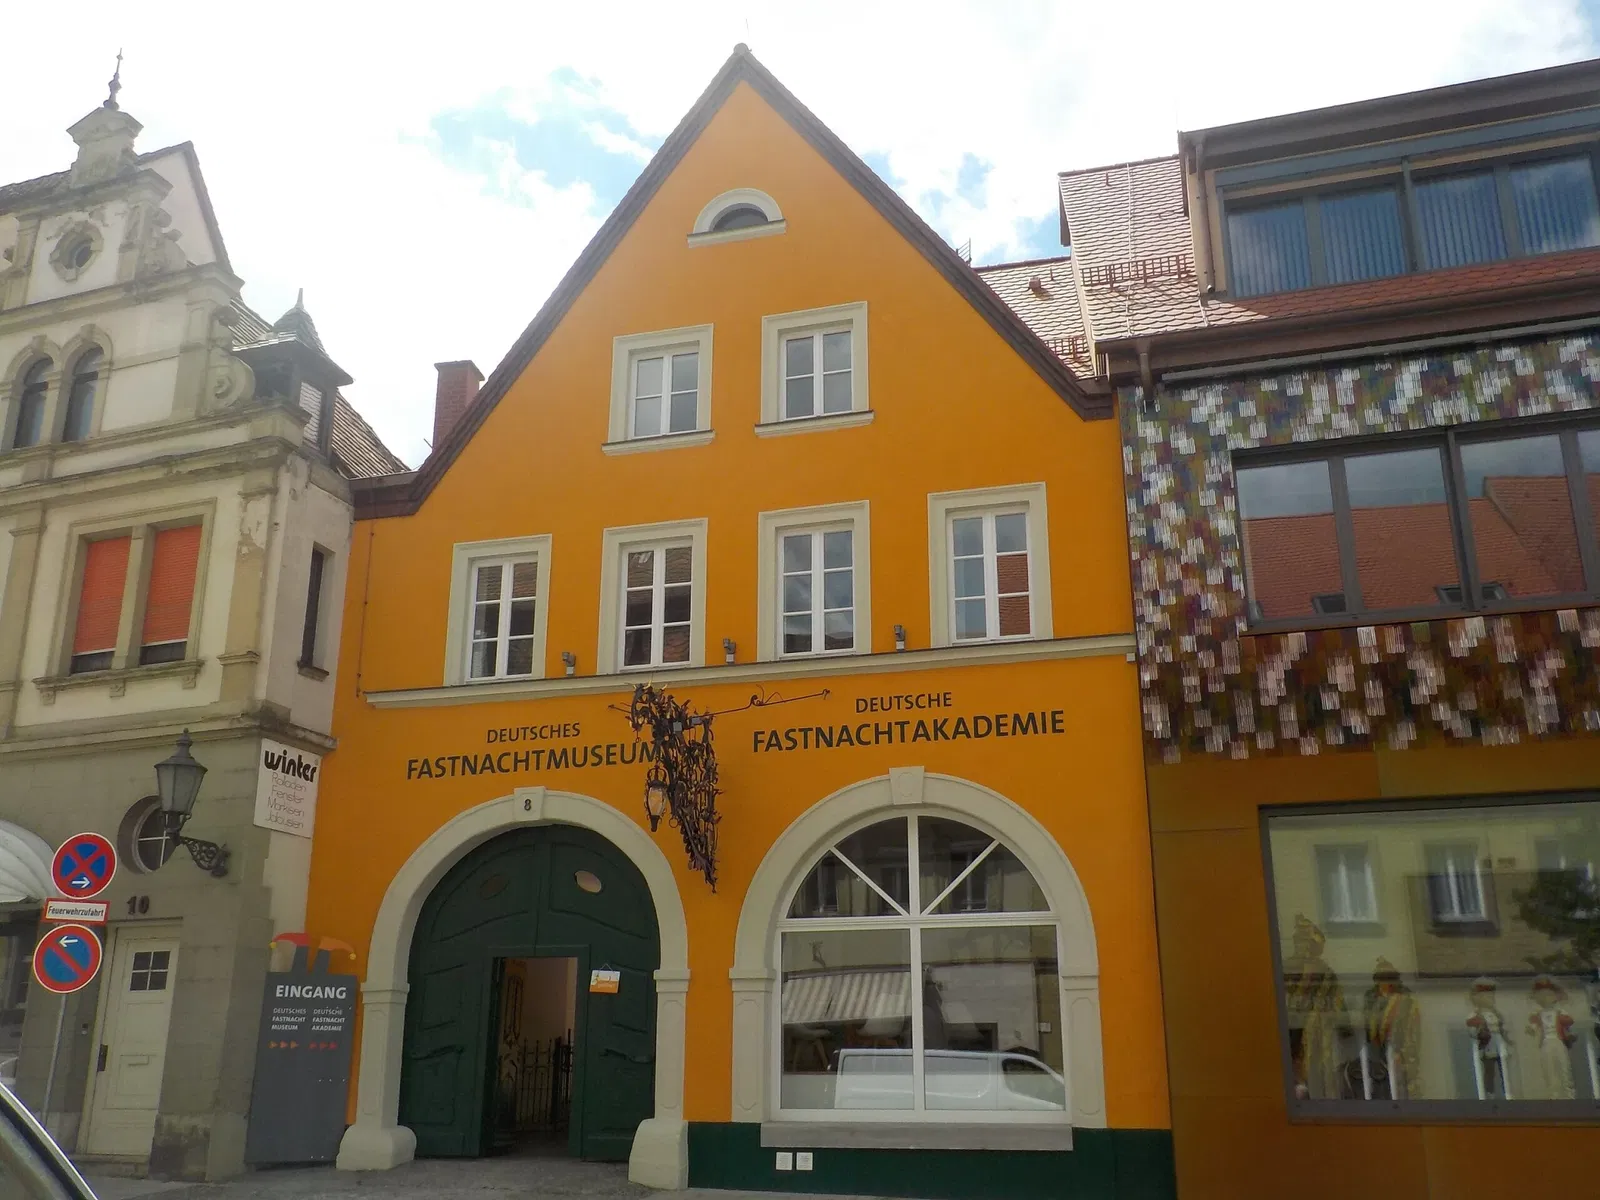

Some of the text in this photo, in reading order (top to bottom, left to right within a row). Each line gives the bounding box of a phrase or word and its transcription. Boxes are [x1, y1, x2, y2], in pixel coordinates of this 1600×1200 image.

[856, 692, 952, 714] DEUTSCHE
[487, 722, 580, 744] DEUTSCHES
[753, 710, 1065, 753] FASTNACHTAKADEMIE
[264, 749, 317, 783] winter
[407, 741, 660, 780] FASTNACHTMUSEUM
[271, 784, 304, 804] Fenster
[524, 798, 532, 811] 8
[267, 796, 305, 817] Markisen
[48, 906, 104, 917] Feuerwehrzufahrt
[126, 896, 150, 915] 10
[276, 984, 347, 999] EINGANG
